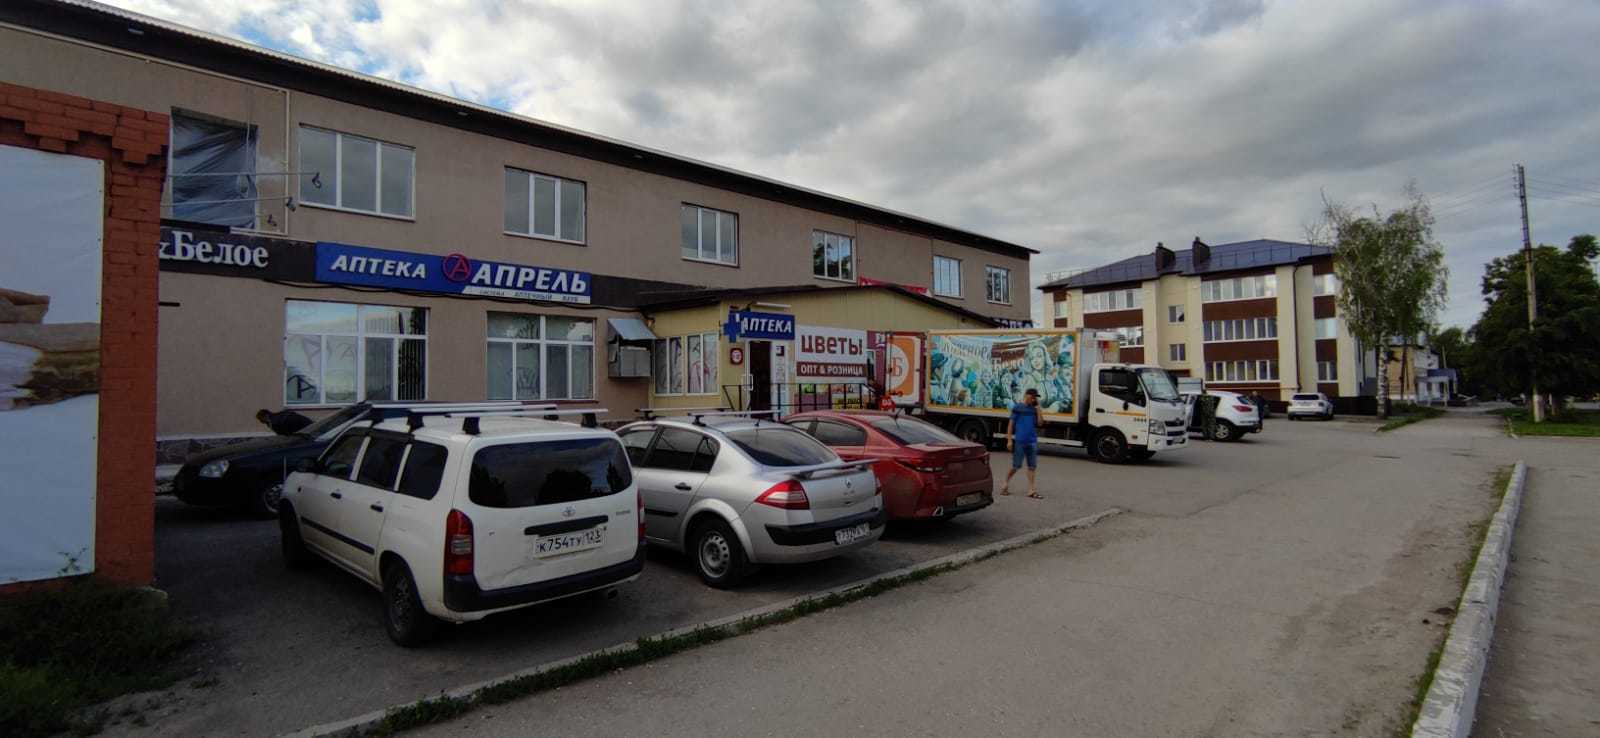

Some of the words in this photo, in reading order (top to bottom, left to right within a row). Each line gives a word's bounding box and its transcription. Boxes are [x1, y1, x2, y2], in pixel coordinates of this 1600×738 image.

[331, 254, 426, 279] АПТЕКА
[472, 263, 587, 293] АПРЕЛЬ
[740, 316, 792, 334] АПТЕКА
[801, 365, 817, 375] ОПТ
[828, 366, 863, 376] РОЗНИЦА
